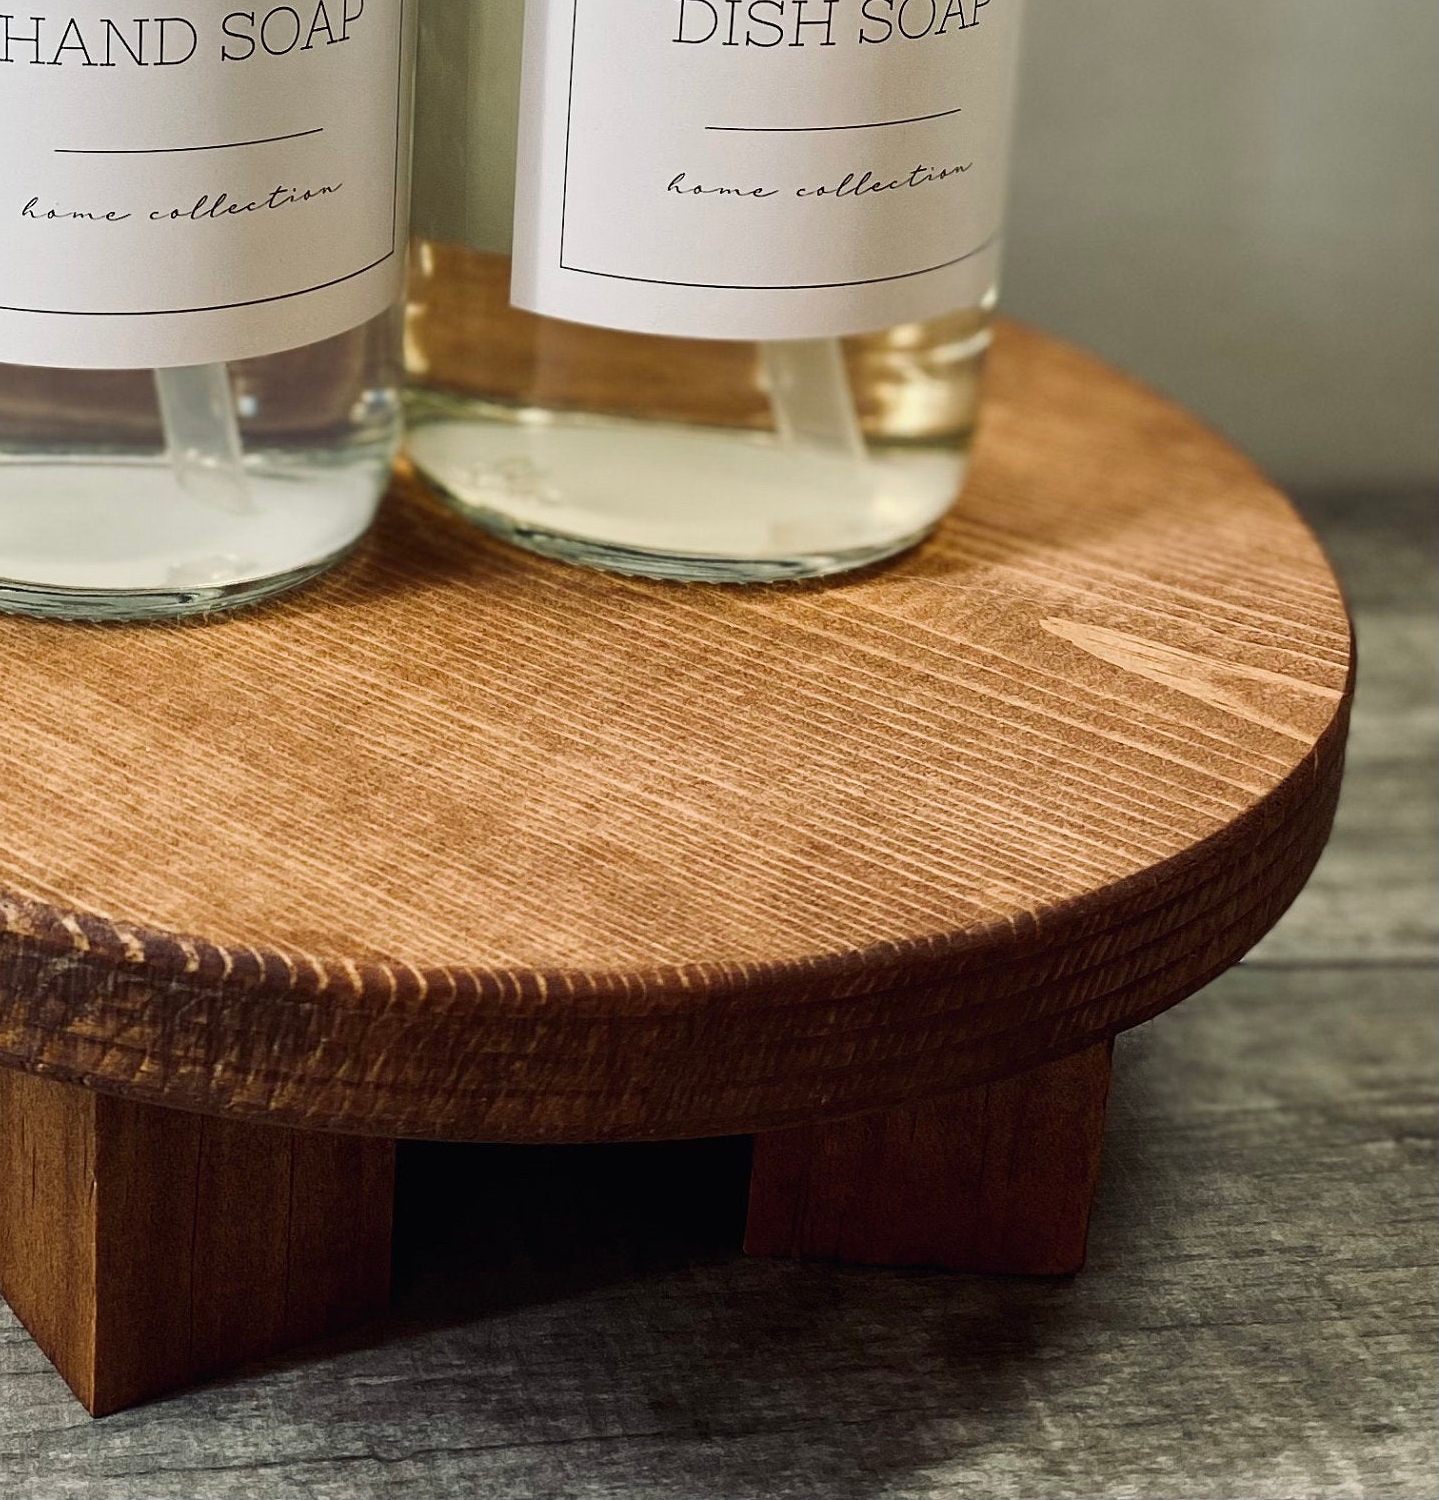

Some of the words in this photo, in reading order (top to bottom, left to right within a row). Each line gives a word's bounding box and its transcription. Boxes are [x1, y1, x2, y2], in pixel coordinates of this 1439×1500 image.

[0, 15, 197, 67] HAND
[667, 172, 780, 198] home
[795, 162, 973, 198] collection
[21, 196, 132, 222] home
[149, 182, 343, 221] collection
